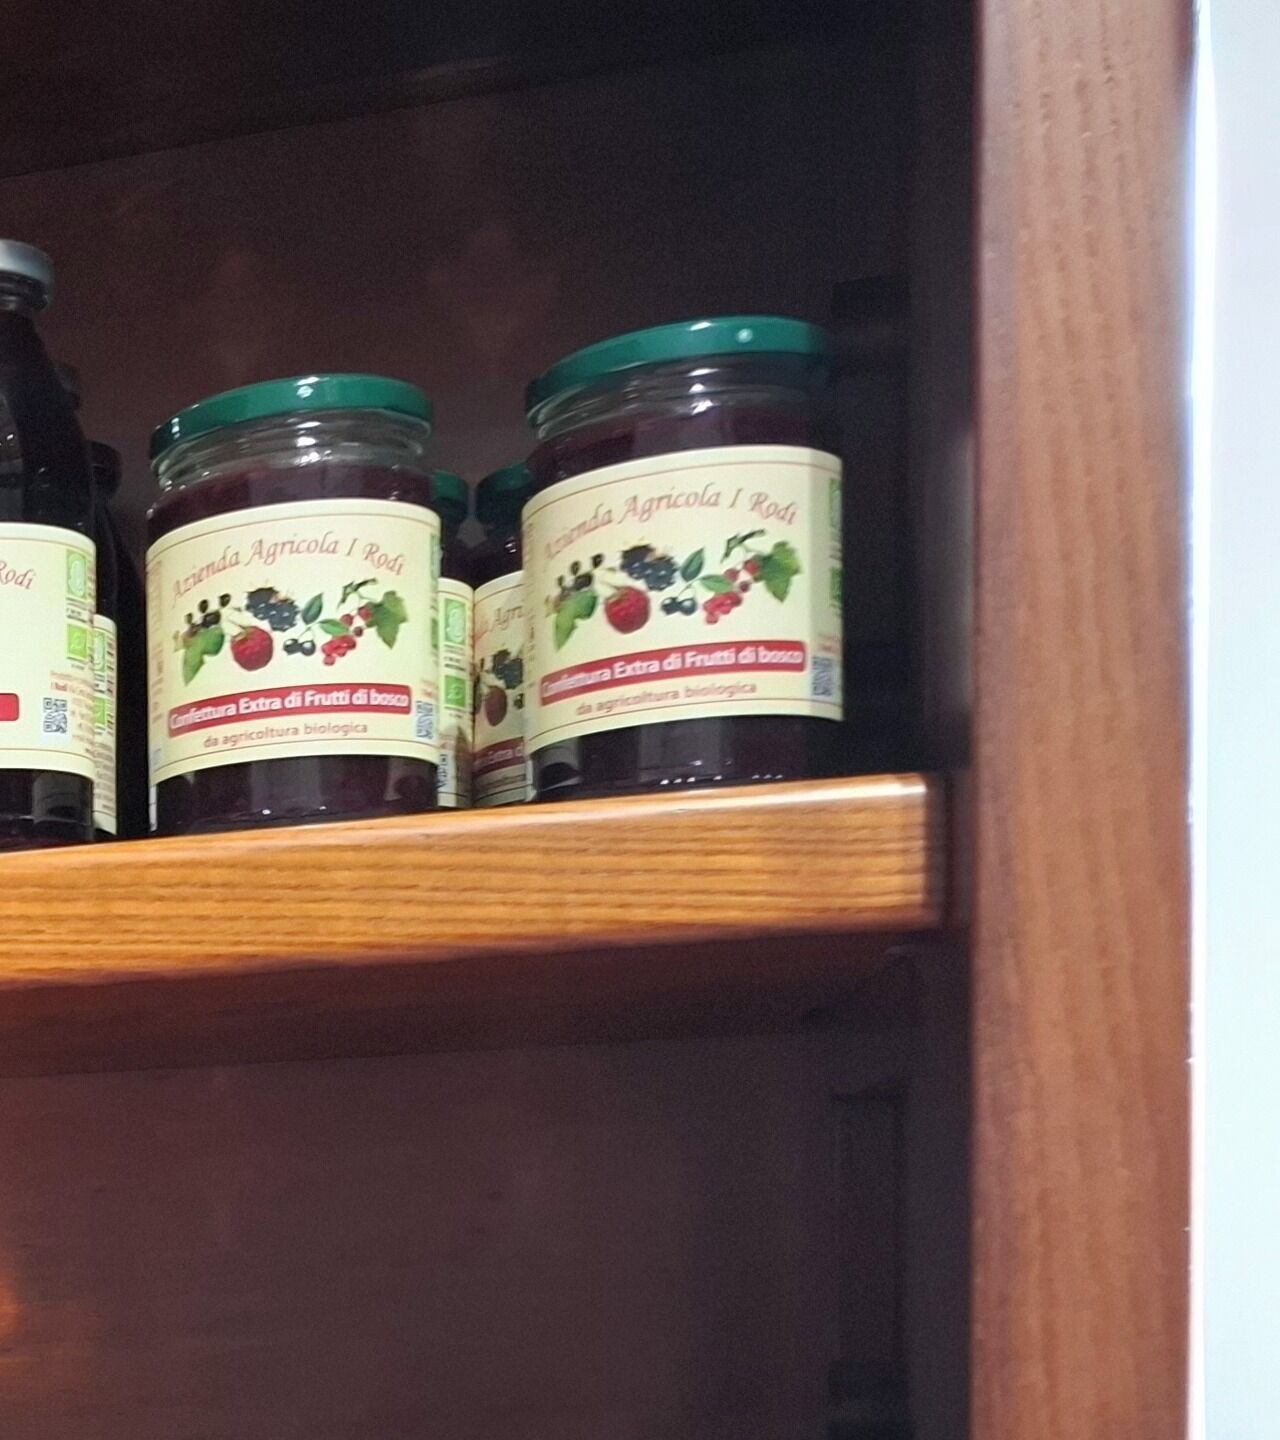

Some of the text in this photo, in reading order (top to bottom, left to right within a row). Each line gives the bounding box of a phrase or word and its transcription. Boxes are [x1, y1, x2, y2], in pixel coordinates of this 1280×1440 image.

[617, 482, 798, 526] Agricola Rodi
[171, 531, 406, 600] Azienda Agricola Rodi
[613, 646, 804, 679] Extra di Frutti di bosco
[170, 689, 409, 730] Confettura Extra di Frutti di bosco
[203, 721, 369, 750] da agricoltura biologica
